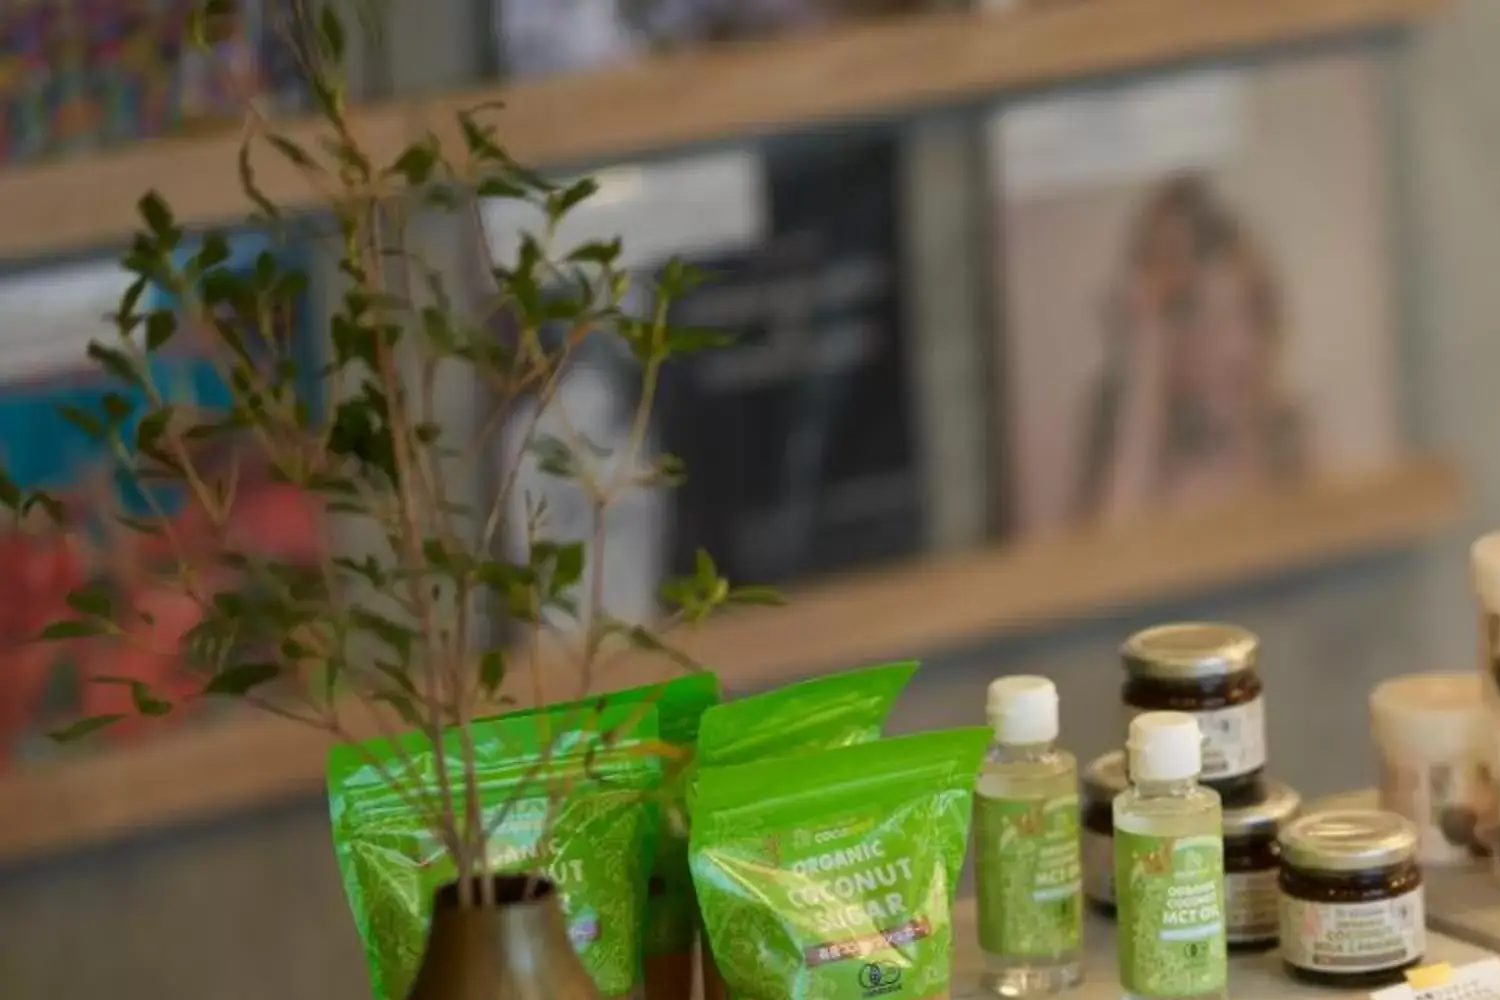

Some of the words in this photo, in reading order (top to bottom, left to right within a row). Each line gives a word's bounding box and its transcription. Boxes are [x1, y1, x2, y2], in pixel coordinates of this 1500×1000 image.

[792, 839, 886, 878] ORGANIC
[787, 857, 914, 908] COCONUT
[813, 892, 908, 933] SUGAR
[1162, 908, 1197, 925] MCT
